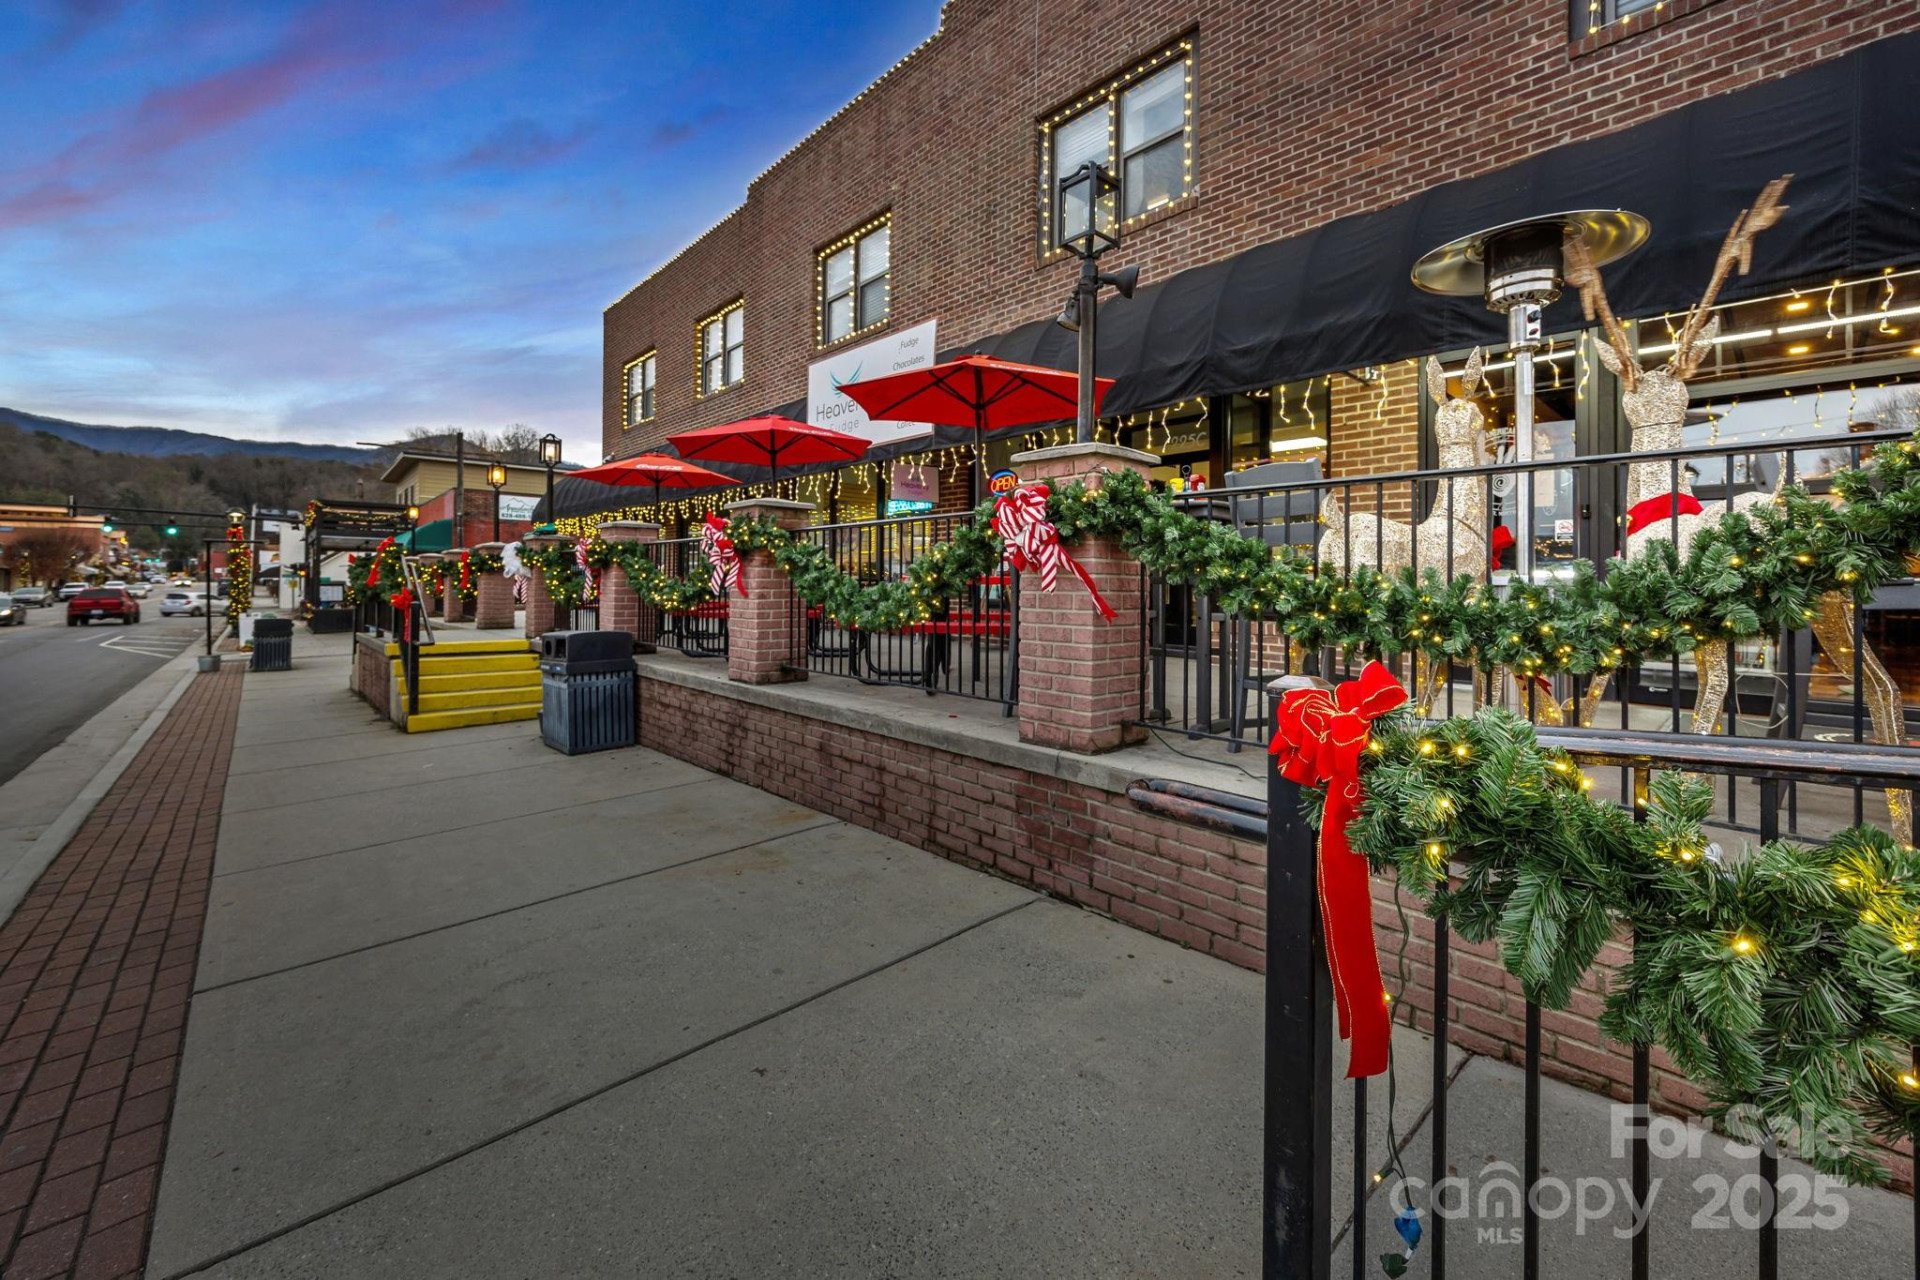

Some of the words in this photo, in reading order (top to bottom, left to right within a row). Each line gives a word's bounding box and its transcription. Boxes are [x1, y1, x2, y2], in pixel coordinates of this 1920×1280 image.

[900, 337, 919, 349] Fudge
[892, 355, 925, 371] Chocolates
[990, 475, 1016, 492] OPEN
